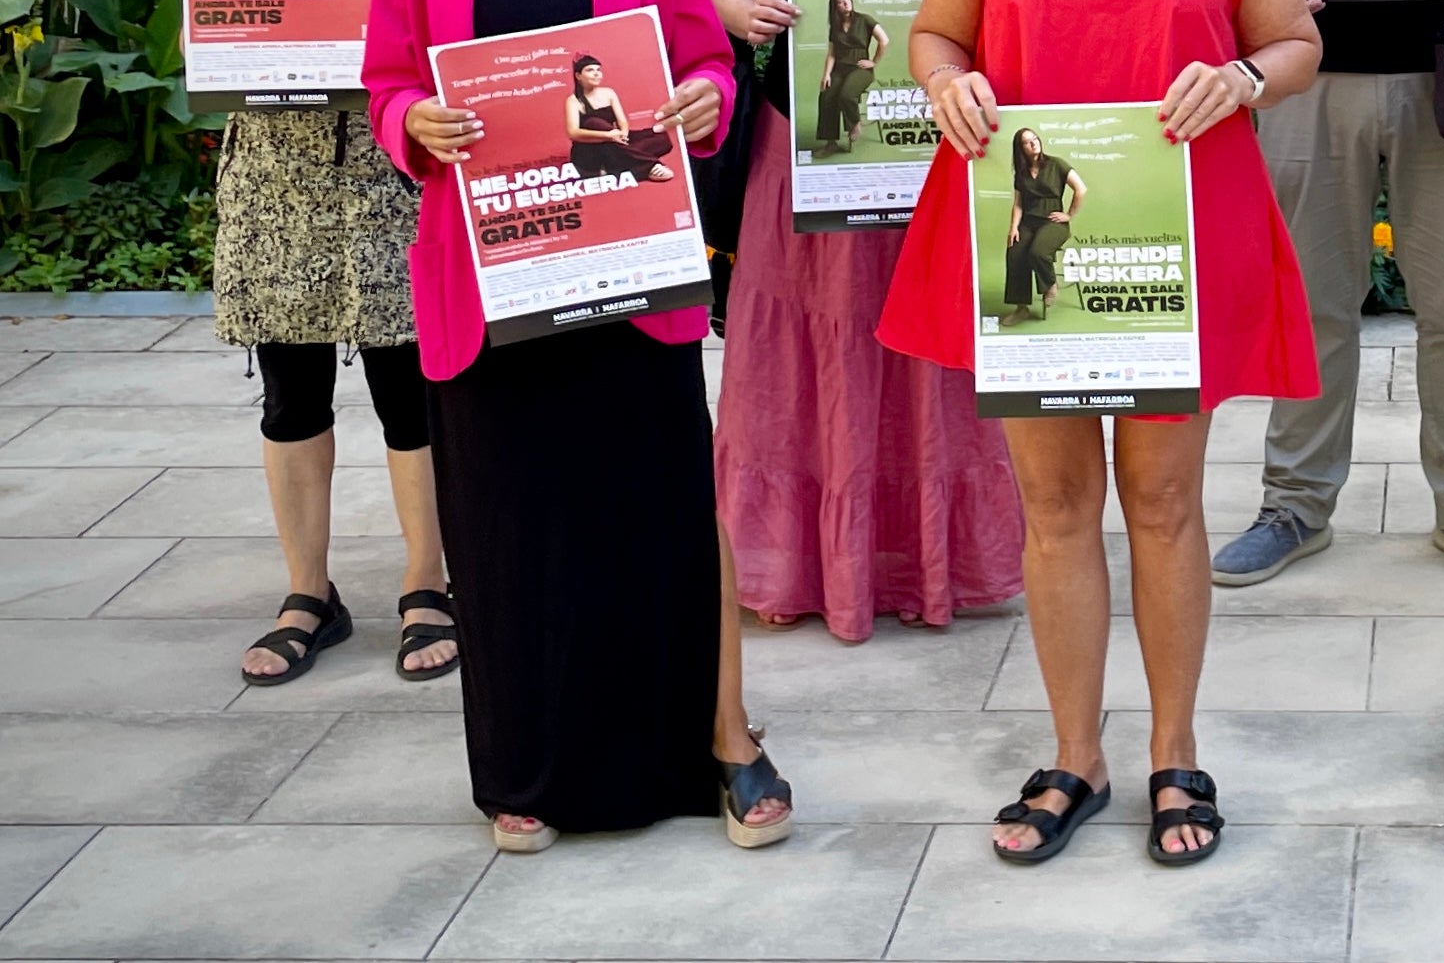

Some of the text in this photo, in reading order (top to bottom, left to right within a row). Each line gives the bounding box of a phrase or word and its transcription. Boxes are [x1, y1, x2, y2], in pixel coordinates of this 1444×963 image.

[194, 10, 282, 25] GRATIS
[866, 89, 930, 104] APRE
[883, 122, 920, 130] AHORA
[885, 131, 943, 145] GRAT
[470, 163, 580, 197] MEJORA
[474, 172, 638, 215] TU EUSKERA
[479, 201, 582, 228] AHORA TE SALE
[481, 213, 582, 246] GRATIS
[1090, 235, 1099, 244] le
[1102, 234, 1119, 244] des
[1144, 233, 1181, 243] vueltas
[1063, 245, 1183, 264] APRENDE
[1064, 264, 1184, 282] EUSKERA
[1082, 285, 1184, 294] AHORA TE SALE
[1087, 296, 1185, 312] GRATIS
[553, 307, 593, 322] NAVARRA
[1041, 395, 1134, 405] NAVARRA NAFARROA
